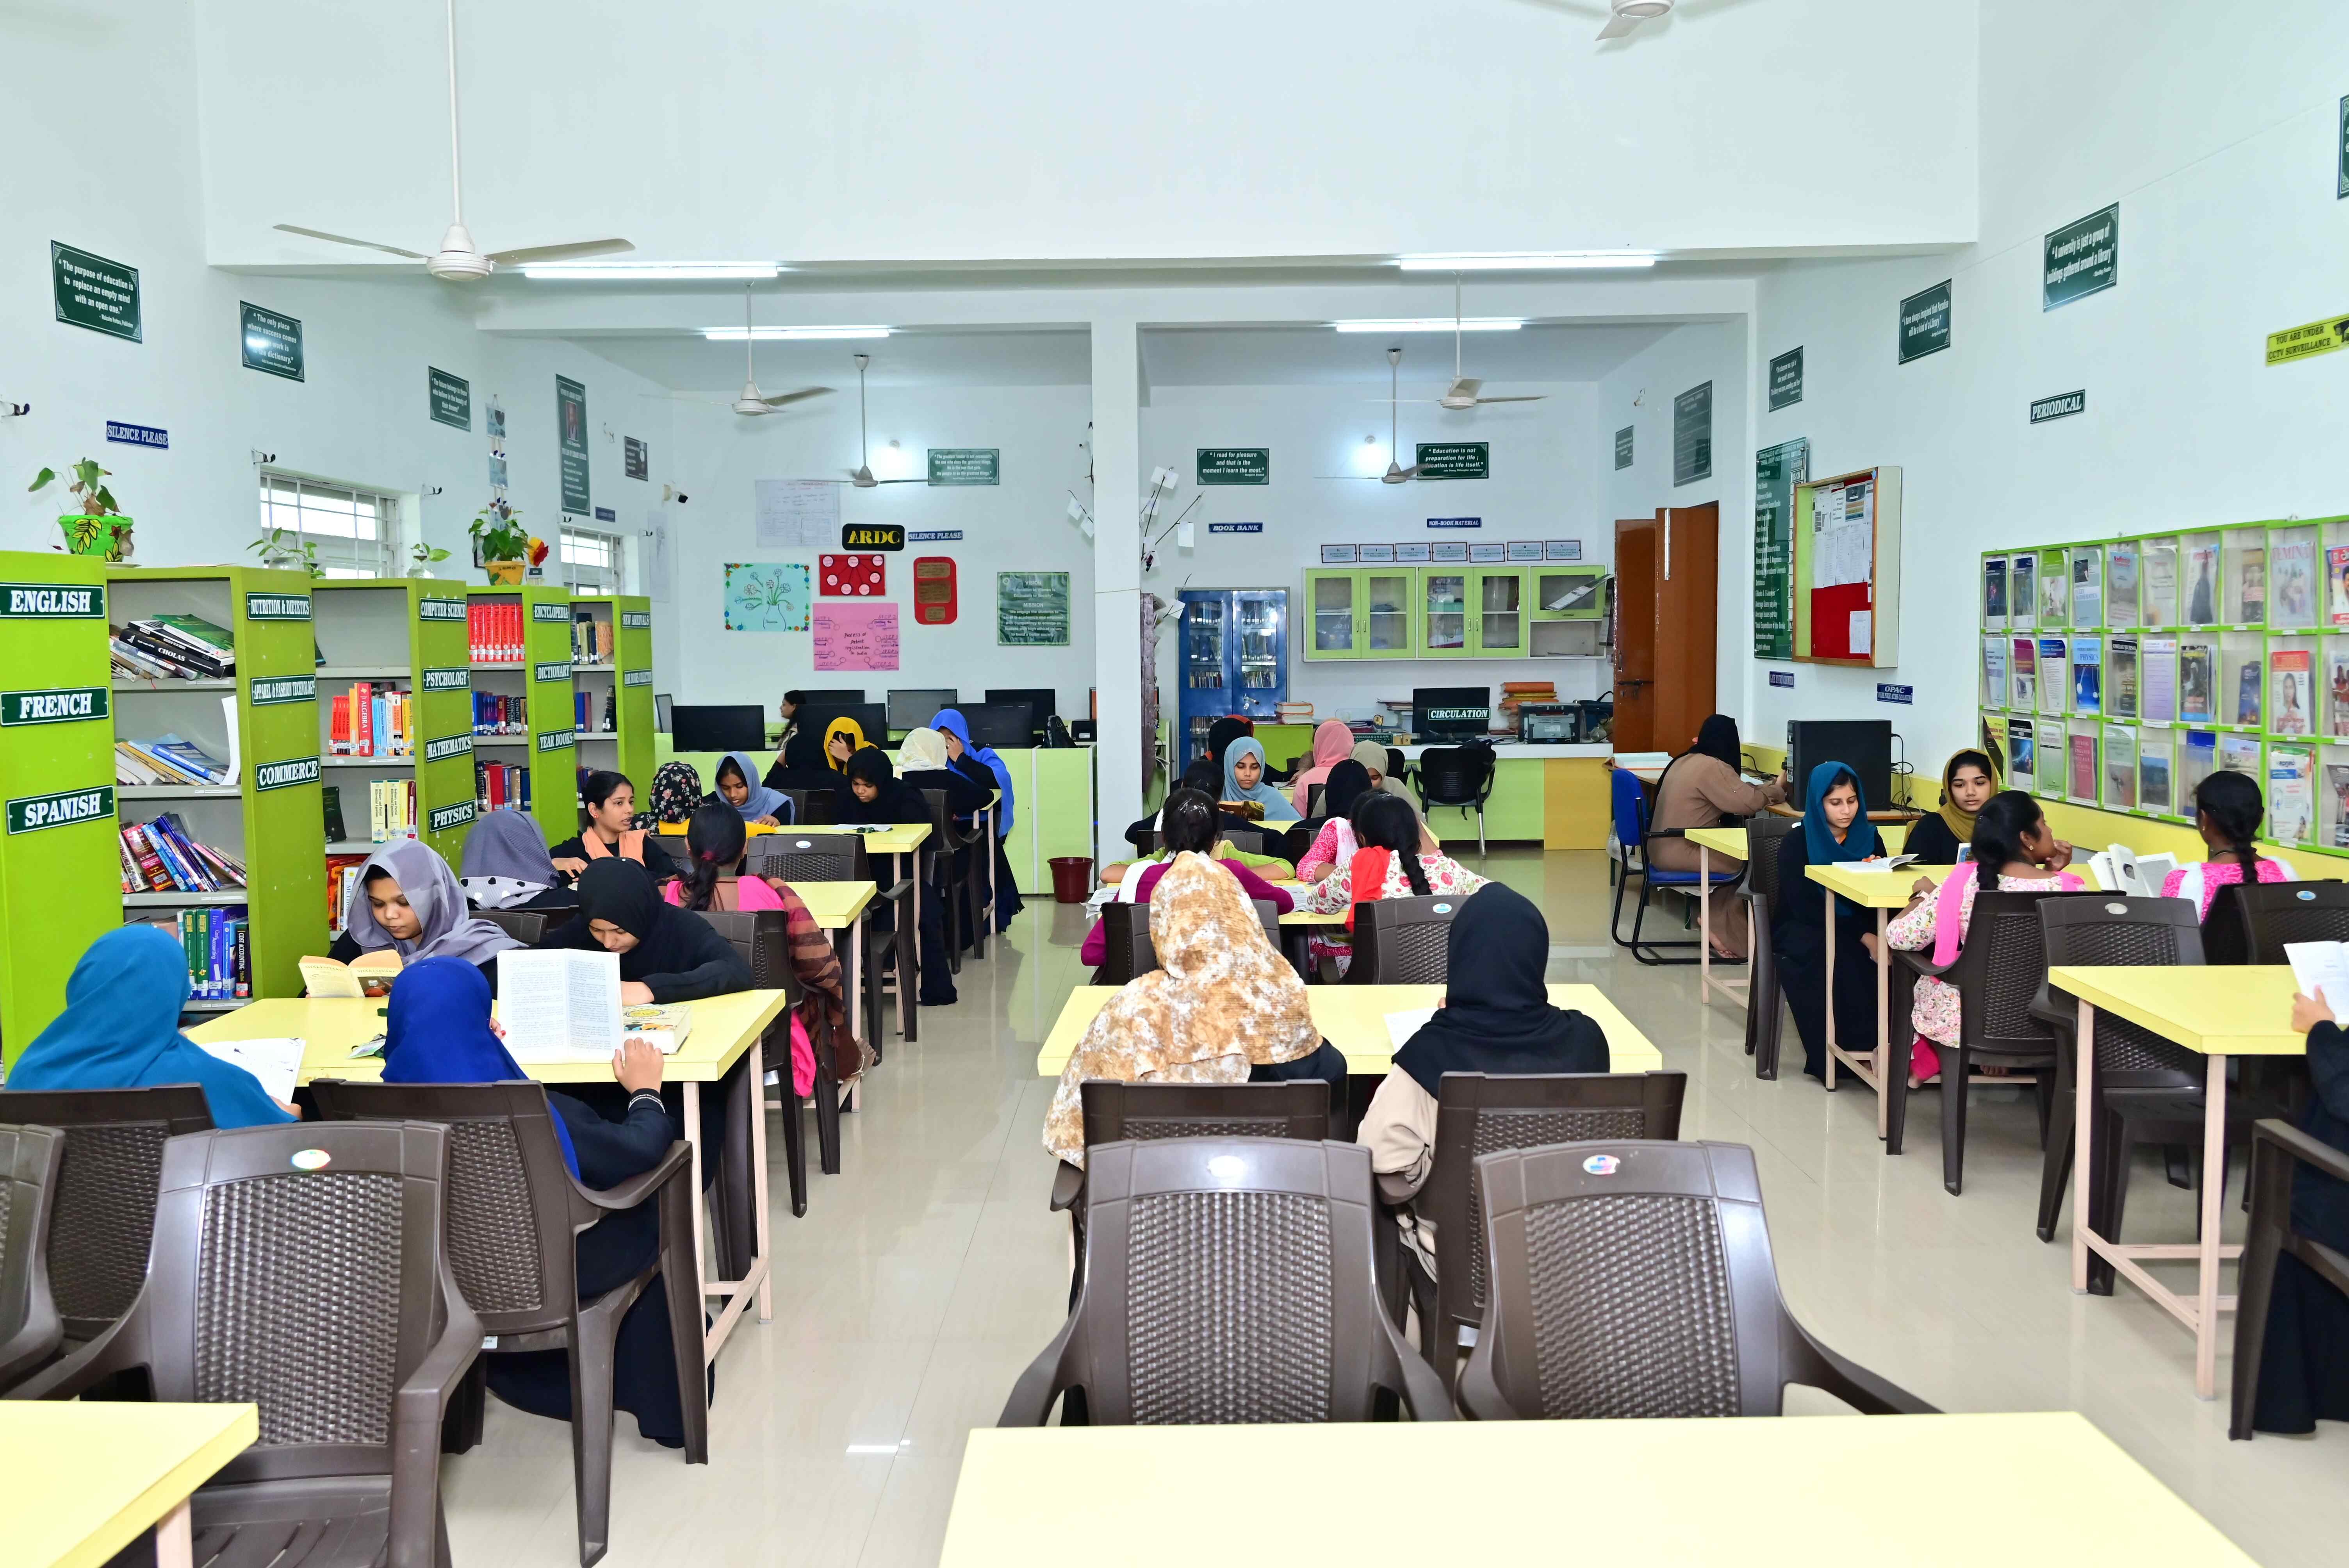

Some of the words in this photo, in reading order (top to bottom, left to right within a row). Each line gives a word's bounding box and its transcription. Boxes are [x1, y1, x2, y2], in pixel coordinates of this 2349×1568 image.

[2058, 237, 2076, 258] university
[2076, 236, 2080, 250] is
[2080, 232, 2089, 252] just
[2092, 228, 2104, 247] group
[2105, 222, 2110, 237] of
[63, 260, 73, 272] The
[75, 265, 96, 279] purpose
[96, 272, 102, 281] of
[103, 275, 128, 289] education
[129, 282, 134, 291] is
[2047, 268, 2063, 284] buildings
[2063, 258, 2080, 281] gathered
[2080, 252, 2094, 271] around
[64, 275, 70, 285] to
[73, 280, 93, 292] replace
[94, 286, 100, 294] an
[102, 289, 117, 301] empty
[118, 294, 130, 304] mind
[75, 294, 87, 305] with
[88, 298, 94, 306] an
[95, 301, 108, 311] open
[1912, 312, 1920, 323] always
[1920, 305, 1932, 319] imagined
[1937, 299, 1949, 312] Paradise
[257, 314, 266, 323] The
[267, 318, 277, 328] only
[278, 321, 290, 330] place
[247, 323, 262, 332] where
[263, 328, 281, 339] success
[282, 334, 297, 344] comes
[2276, 335, 2287, 345] YOU
[2289, 332, 2301, 341] ARE
[2304, 326, 2324, 338] UNDER
[2269, 349, 2284, 359] CCTV
[2285, 338, 2331, 355] SURVEILLANCE
[2032, 395, 2082, 420] PERIODICAL
[107, 425, 140, 441] SILENCE
[141, 430, 168, 445] PLEASE
[847, 530, 900, 544] ARDC
[10, 590, 91, 613] ENGLISH
[251, 599, 280, 615] NUTRITION
[282, 600, 286, 615] &
[286, 600, 310, 615] DIETETICS
[421, 602, 447, 617] COMPUTER
[447, 603, 465, 618] SCIENCE
[534, 606, 569, 619] ENCYCLOPEDIA
[631, 614, 649, 625] ARRIVALS
[158, 647, 186, 662] CHOLAS
[426, 671, 467, 687] PSYCHOLOGY
[538, 665, 570, 679] DICTIONARY
[254, 683, 271, 700] APPAREL
[272, 683, 276, 698] &
[275, 682, 292, 698] FASHION
[292, 681, 314, 696] TECHNOLOGY
[20, 693, 92, 719] FRENCH
[1430, 709, 1488, 718] CIRCULATION
[427, 735, 471, 759] MATHEMATICS
[540, 736, 555, 749] YEAR
[555, 731, 573, 747] BOOKS
[259, 761, 318, 786] COMMERCE
[25, 793, 101, 827] SPANISH
[434, 804, 472, 828] PHYSICS
